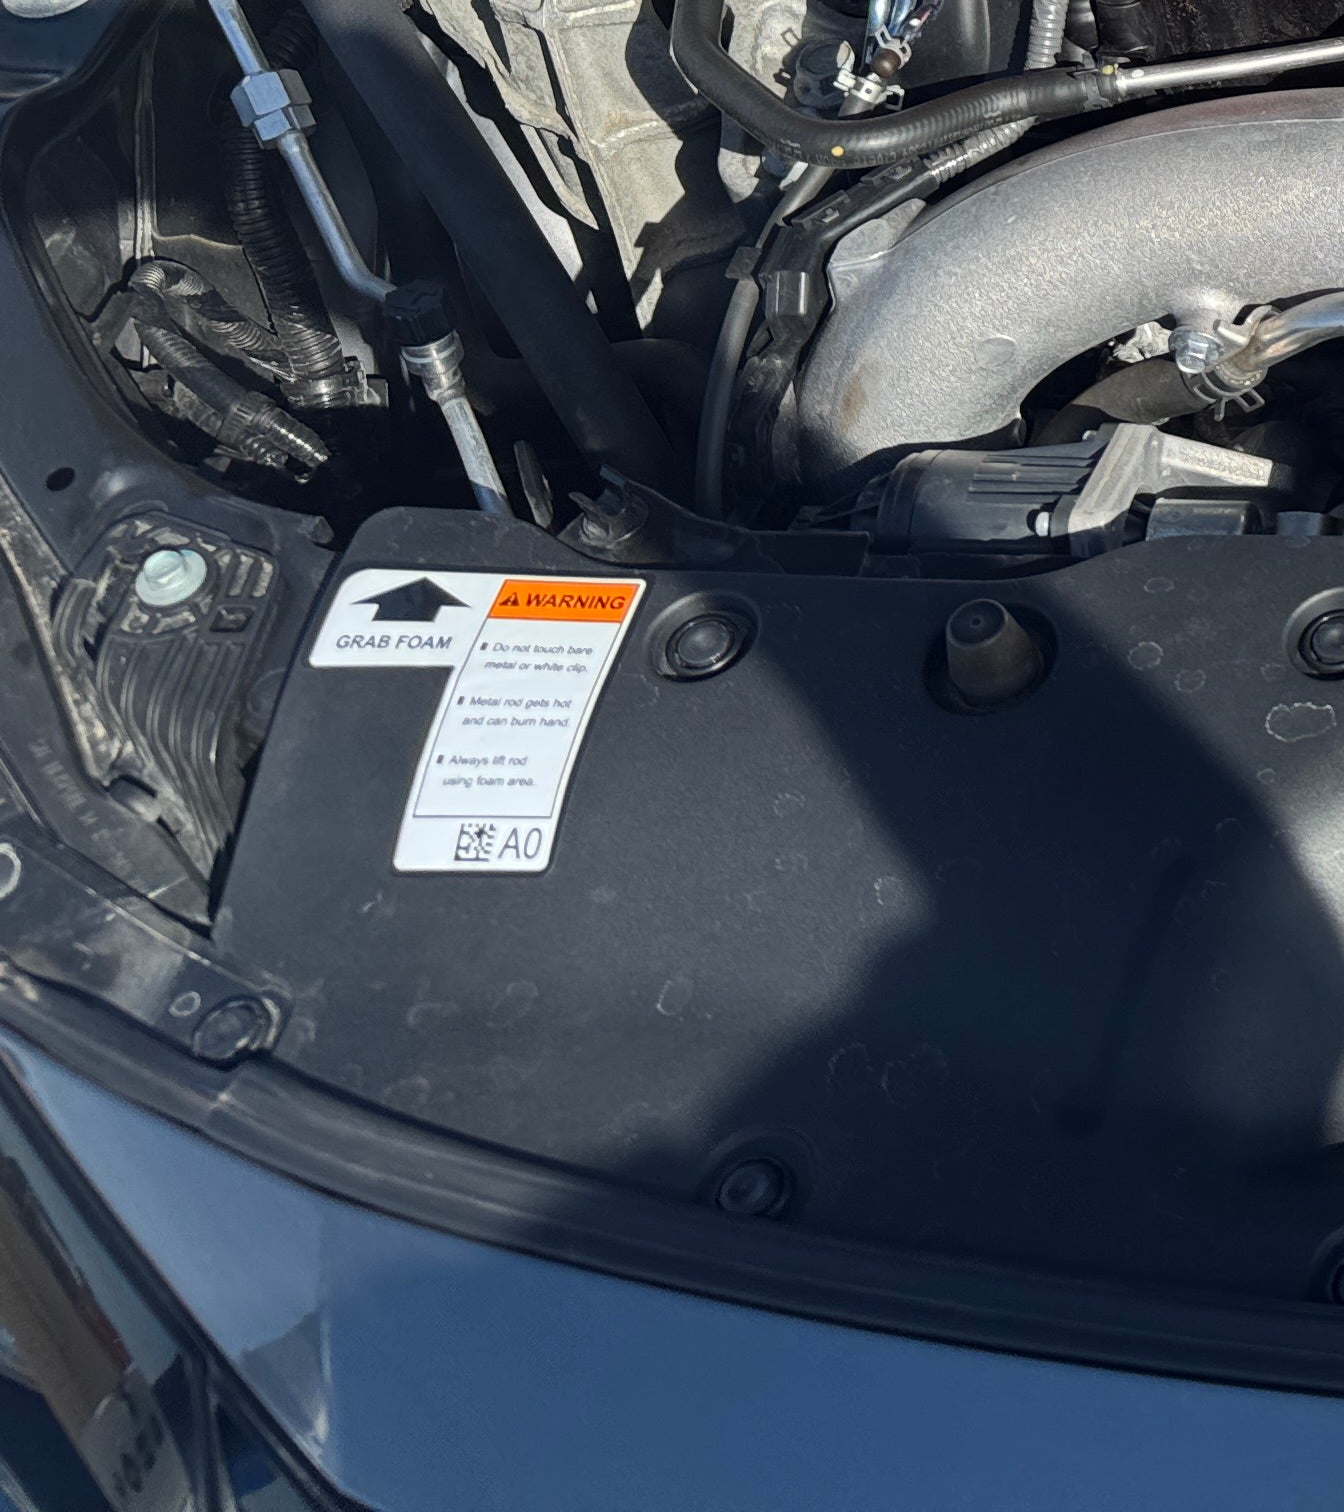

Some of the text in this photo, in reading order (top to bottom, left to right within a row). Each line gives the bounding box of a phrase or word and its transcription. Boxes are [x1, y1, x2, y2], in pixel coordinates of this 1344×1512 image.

[526, 592, 627, 610] WARNING
[336, 634, 452, 650] GRAB FOAM
[492, 642, 593, 656] Do not touch bare
[484, 660, 517, 671] metal
[518, 662, 532, 671] or
[533, 661, 564, 672] white
[469, 696, 573, 710] Metal rod gets hot
[461, 716, 485, 727] and
[486, 717, 508, 727] can
[510, 716, 537, 727] burn
[448, 754, 528, 768] Always lift rod
[442, 775, 473, 789] using
[476, 775, 505, 786] foam
[497, 827, 544, 860] A0
